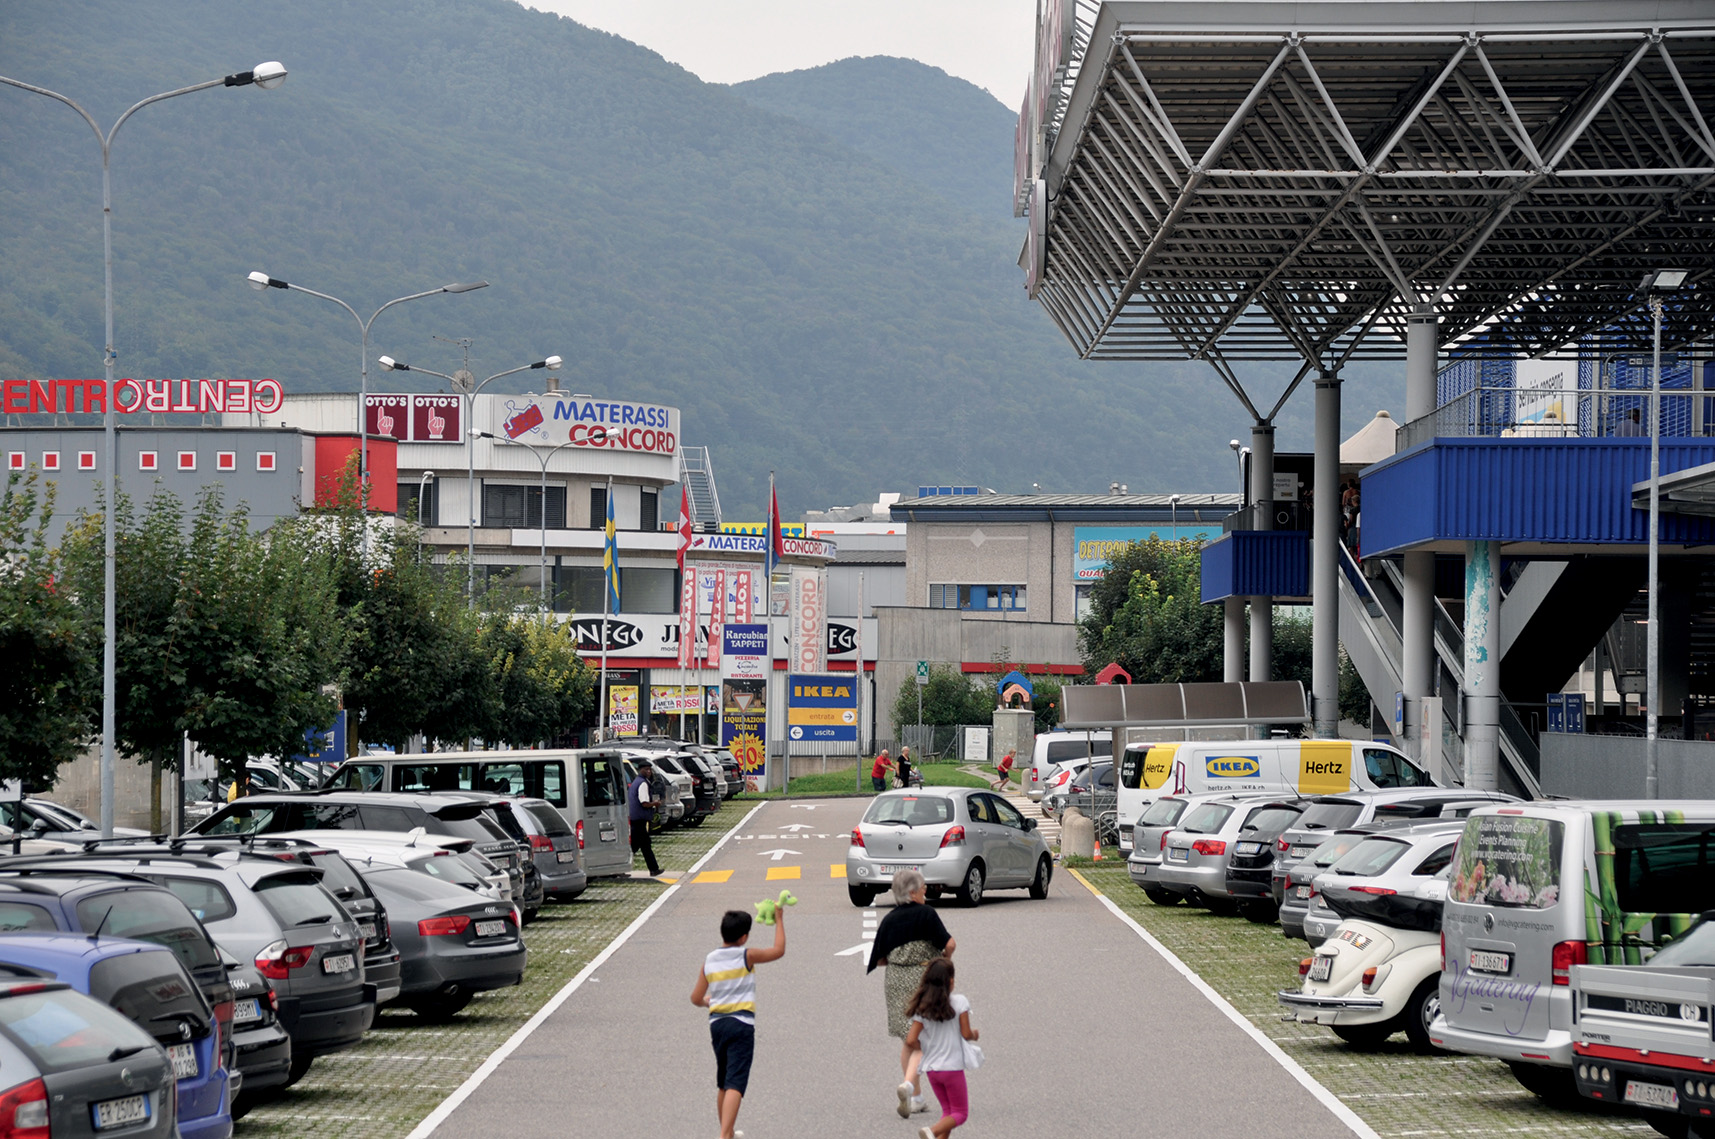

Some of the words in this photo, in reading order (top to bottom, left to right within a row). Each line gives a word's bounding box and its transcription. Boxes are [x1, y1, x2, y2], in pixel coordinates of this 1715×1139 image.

[365, 396, 407, 407] OTTO'S
[415, 397, 458, 408] OTTO'S
[553, 400, 669, 428] MATERASSI
[569, 424, 675, 453] CONCORD
[783, 540, 823, 555] CONCORD
[800, 578, 816, 673] CONCORD
[730, 640, 764, 648] TAPPETI
[794, 686, 850, 697] IKEA
[1146, 764, 1165, 773] Hertz
[1213, 762, 1254, 771] IKEA
[1305, 761, 1343, 774] Hertz
[1493, 822, 1513, 833] Fusion
[1513, 823, 1538, 834] Cuisine
[1479, 835, 1497, 845] Events
[1497, 836, 1527, 848] Planning
[1452, 960, 1541, 1035] VGcatering
[1625, 999, 1668, 1016] PIAGGIO
[1683, 1004, 1697, 1020] CH
[1582, 1032, 1611, 1041] PORTER
